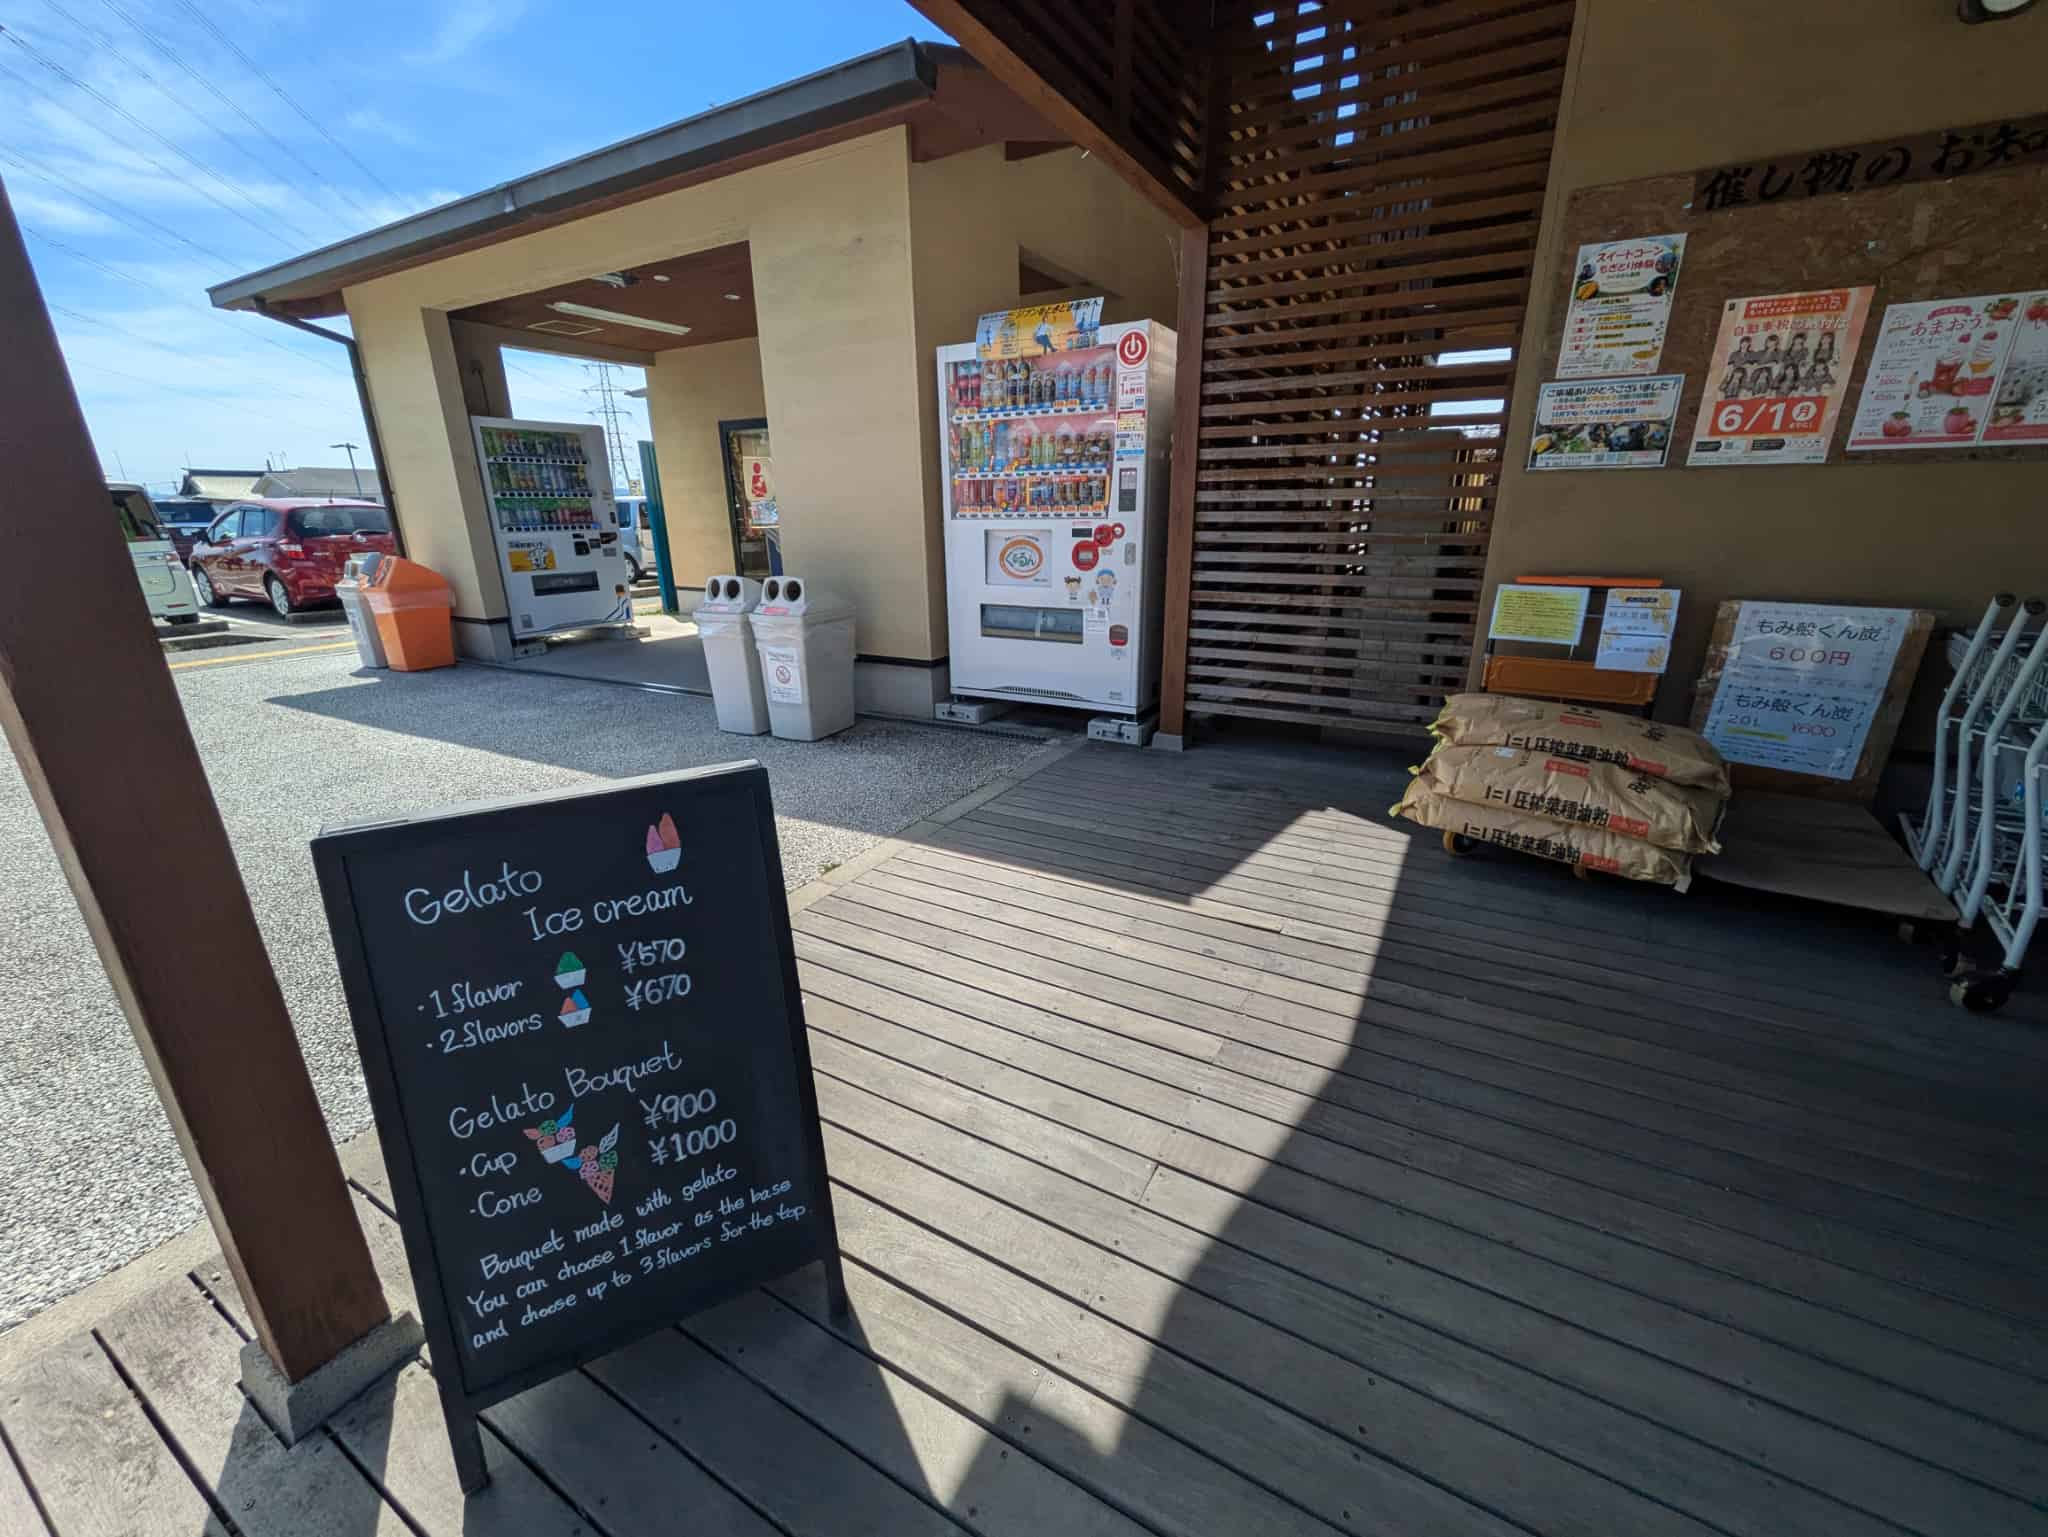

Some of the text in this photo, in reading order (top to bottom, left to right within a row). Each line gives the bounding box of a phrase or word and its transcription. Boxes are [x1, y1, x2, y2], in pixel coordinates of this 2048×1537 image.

[1911, 314, 1984, 337] あまおう
[404, 862, 543, 925] Gelato
[523, 885, 694, 941] Ice cream
[451, 980, 524, 1014] flavor
[617, 937, 686, 974] ¥570
[464, 1013, 543, 1048] flavors
[623, 973, 692, 1011] ¥670
[449, 1039, 683, 1139] Gelato Bouquet
[639, 1087, 717, 1129] ¥900
[477, 1118, 737, 1219] Cone ¥1000
[467, 1179, 793, 1319] You can choose 1 flavor as the base
[480, 1163, 738, 1281] Bouquet made with gelato
[472, 1202, 807, 1349] and choose up to 3 flavors for the top
